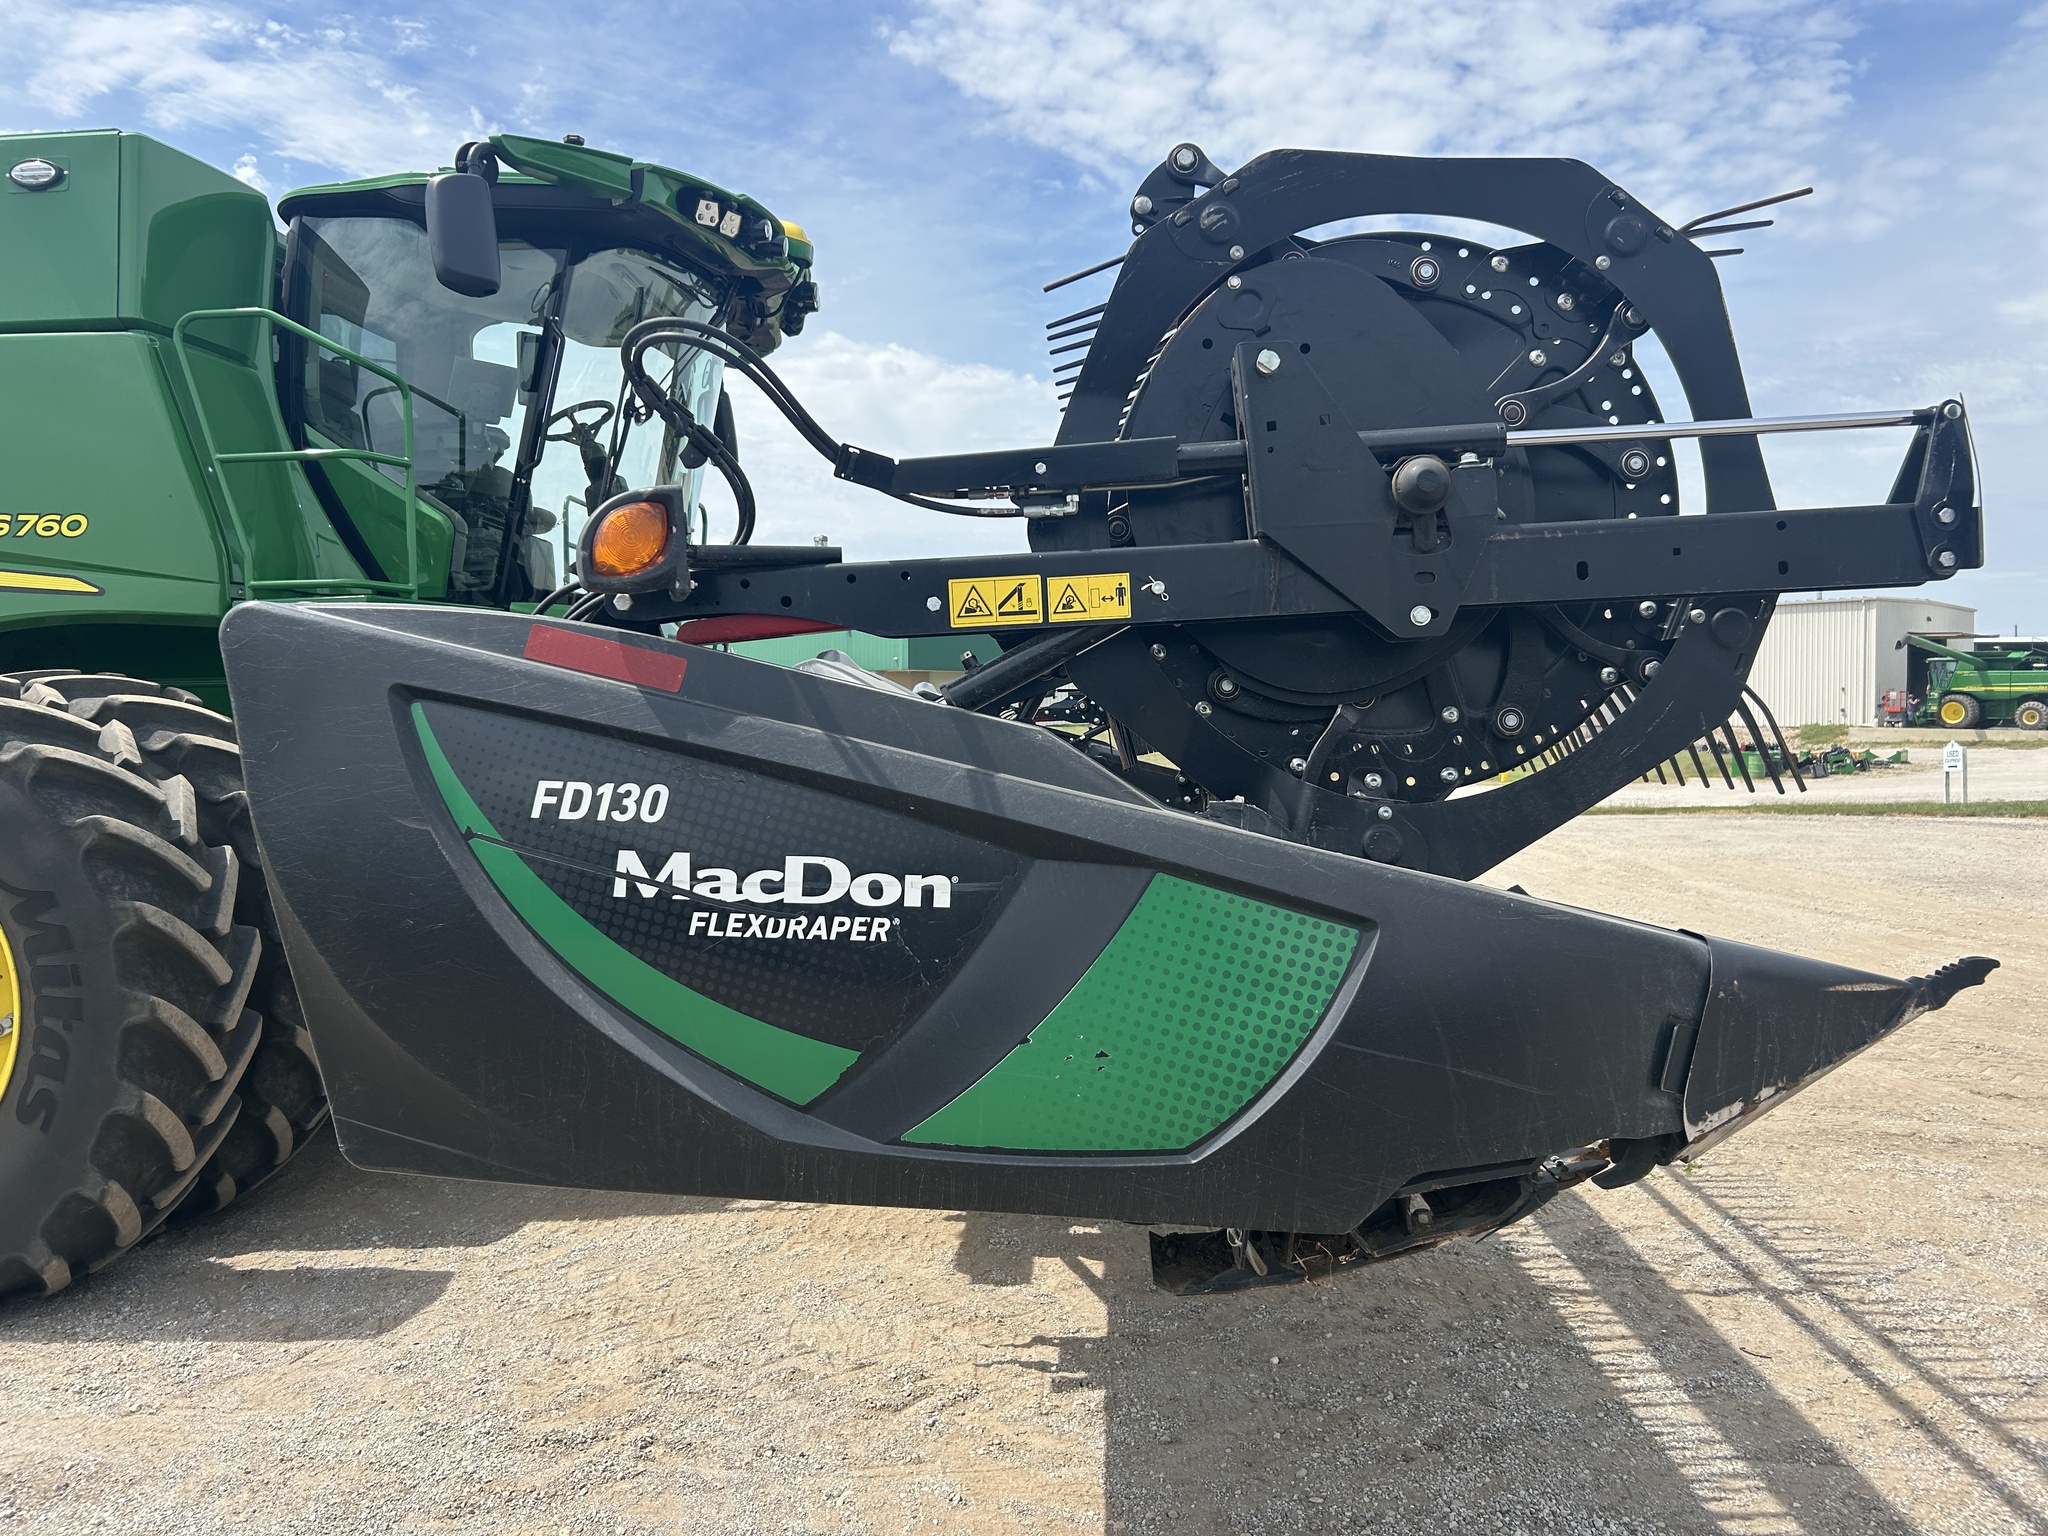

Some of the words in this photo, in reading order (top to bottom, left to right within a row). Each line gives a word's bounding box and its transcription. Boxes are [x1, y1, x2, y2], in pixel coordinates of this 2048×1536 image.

[1946, 750, 1959, 758] USED
[530, 780, 671, 824] FD130
[612, 850, 952, 909] MacDon
[688, 912, 890, 943] FLEXDRAPER
